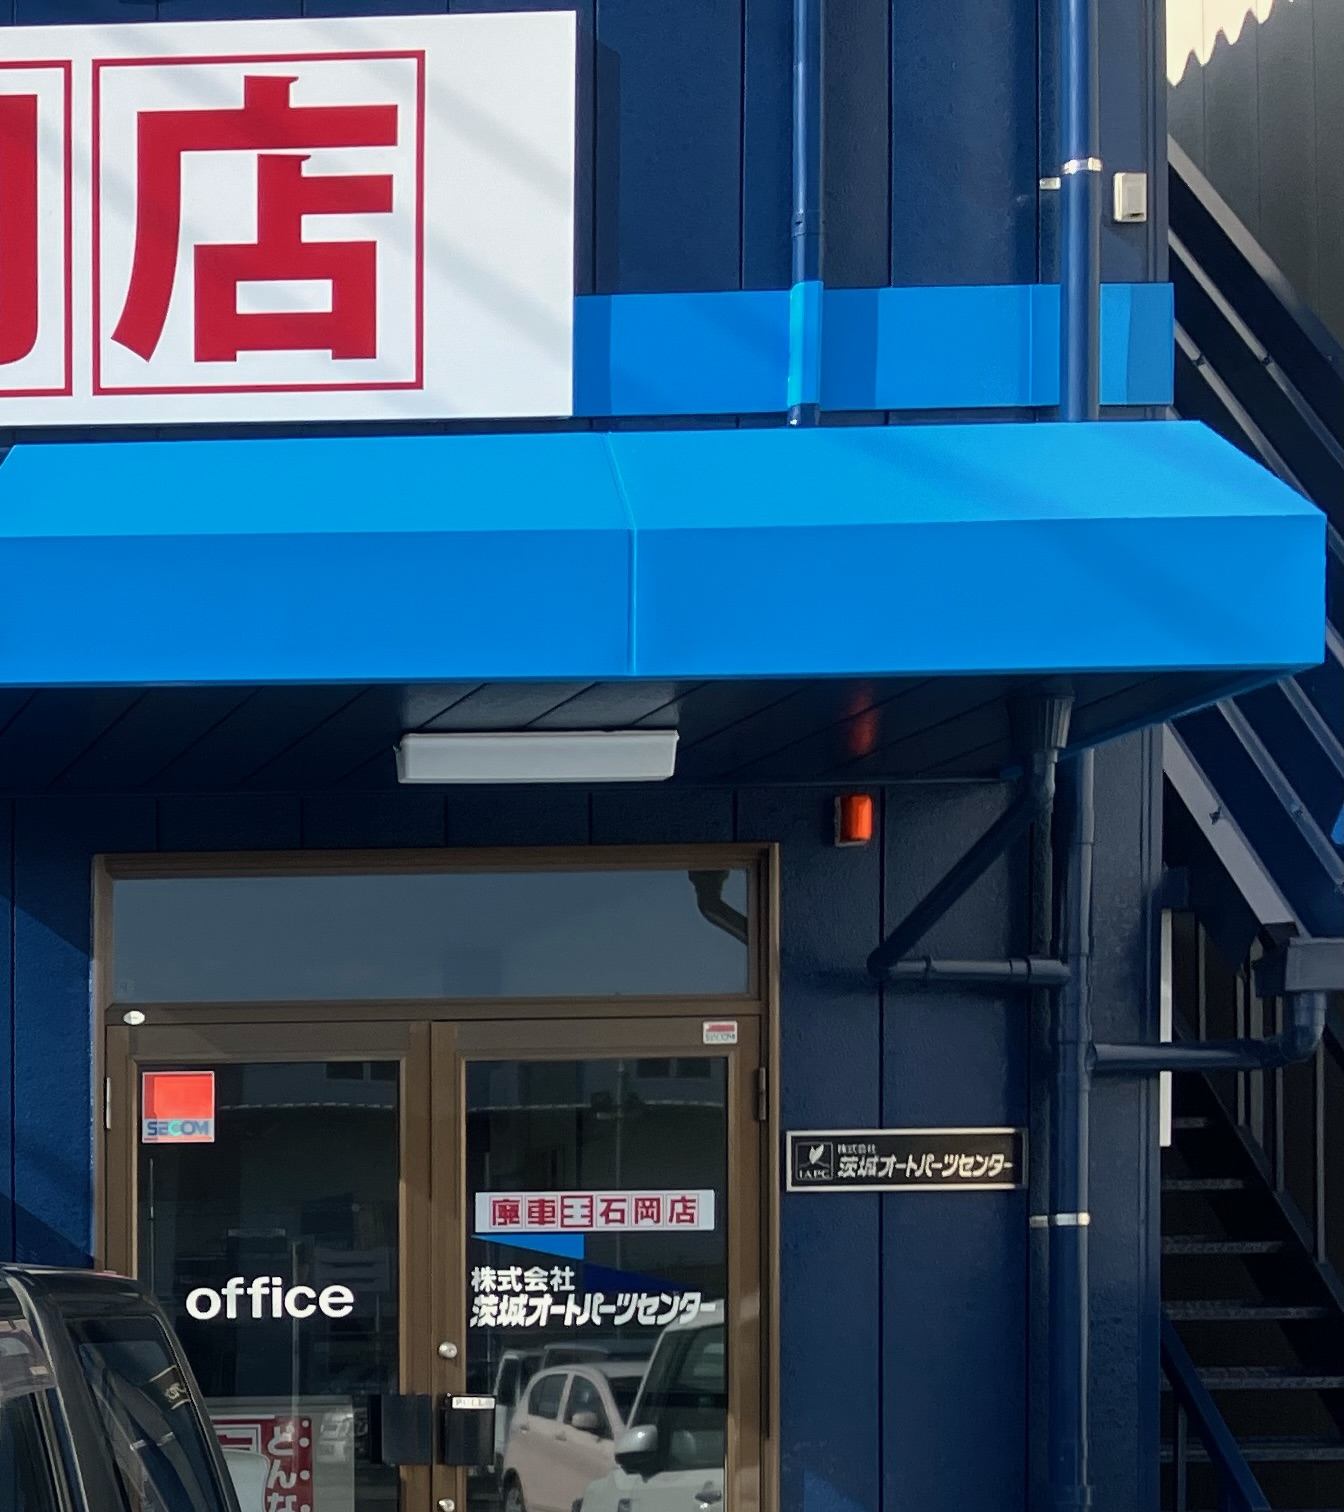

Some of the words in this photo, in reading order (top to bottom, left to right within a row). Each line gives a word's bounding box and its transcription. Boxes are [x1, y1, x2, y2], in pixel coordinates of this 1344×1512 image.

[146, 1119, 209, 1136] SECOM
[837, 1154, 1013, 1178] 茨城オートパーツセンター
[491, 1194, 698, 1229] 廃車王石岡店
[471, 1266, 576, 1293] 株式会社
[185, 1276, 355, 1320] office
[469, 1292, 717, 1328] 茨城オートパーツセンター
